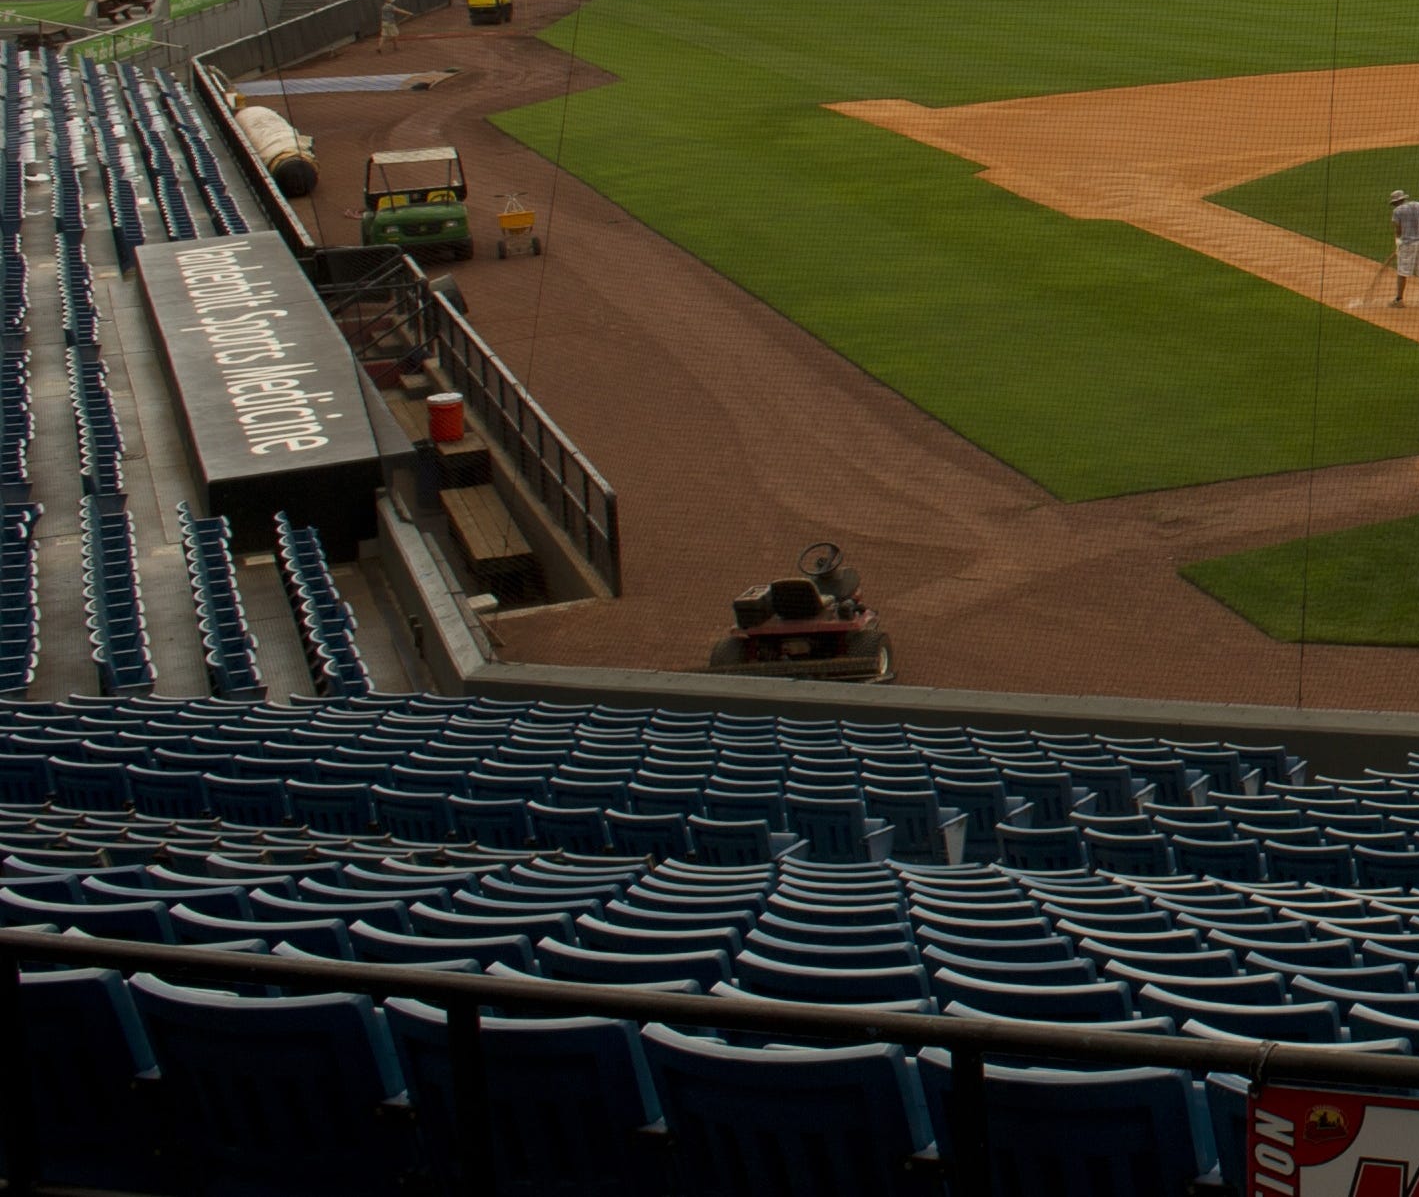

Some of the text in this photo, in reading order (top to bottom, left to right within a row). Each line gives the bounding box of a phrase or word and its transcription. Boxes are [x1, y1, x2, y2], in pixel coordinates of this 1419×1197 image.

[174, 241, 279, 313] Vanderbilt
[180, 309, 296, 365] Sports
[222, 362, 343, 454] Medicine
